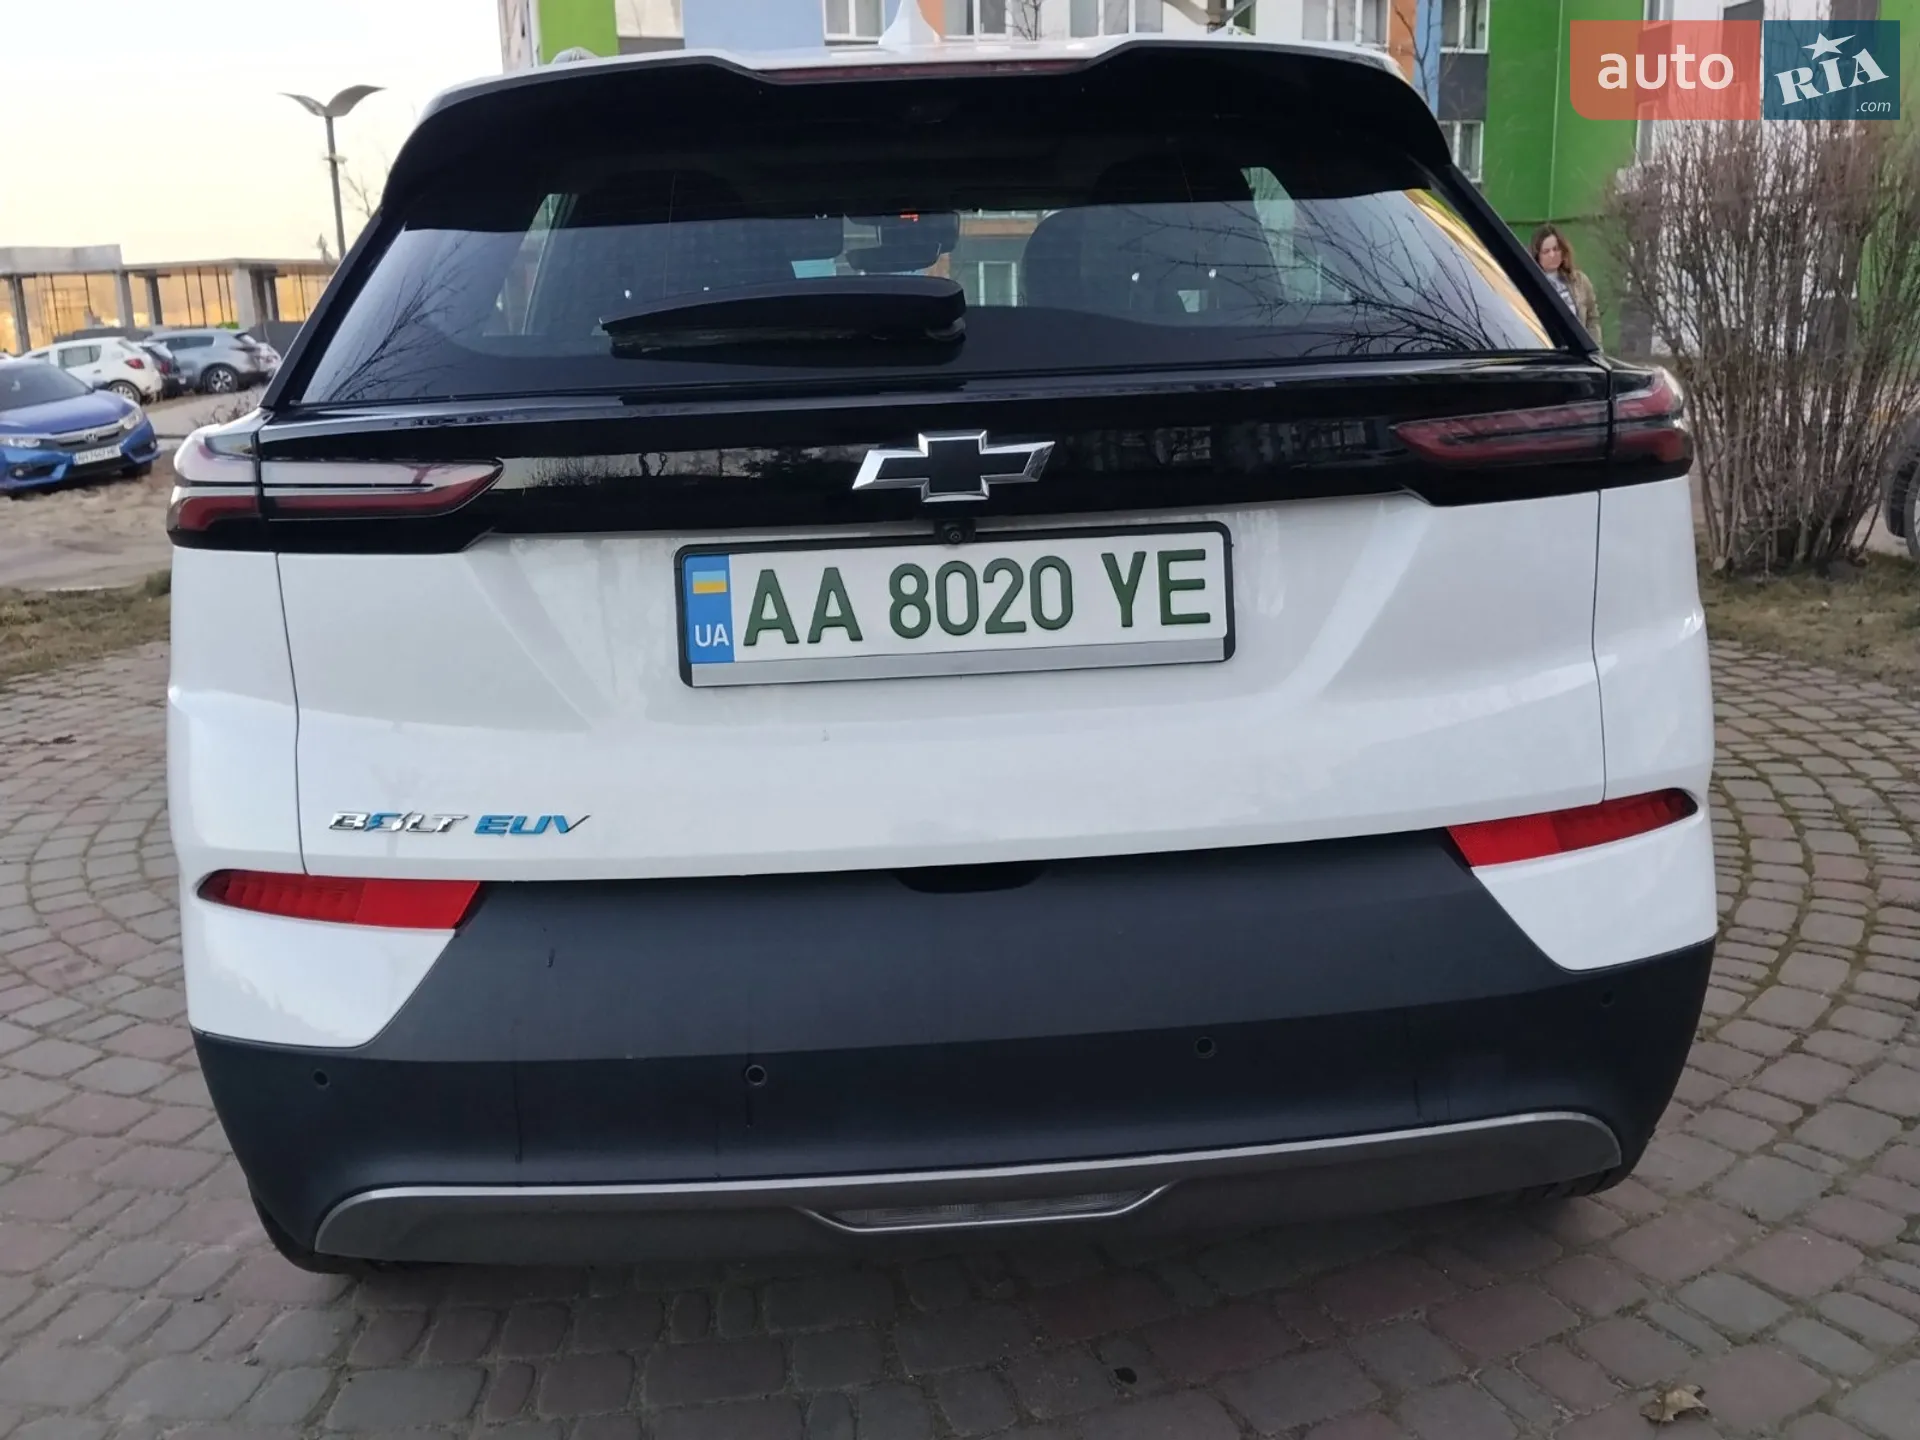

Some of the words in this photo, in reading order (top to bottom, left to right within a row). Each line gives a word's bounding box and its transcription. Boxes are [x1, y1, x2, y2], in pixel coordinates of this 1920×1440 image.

[743, 566, 863, 647] AA
[889, 555, 1073, 639] 8020
[1101, 548, 1211, 627] YE
[695, 624, 730, 648] UA
[328, 811, 469, 833] BOLT
[474, 814, 591, 837] EUV
